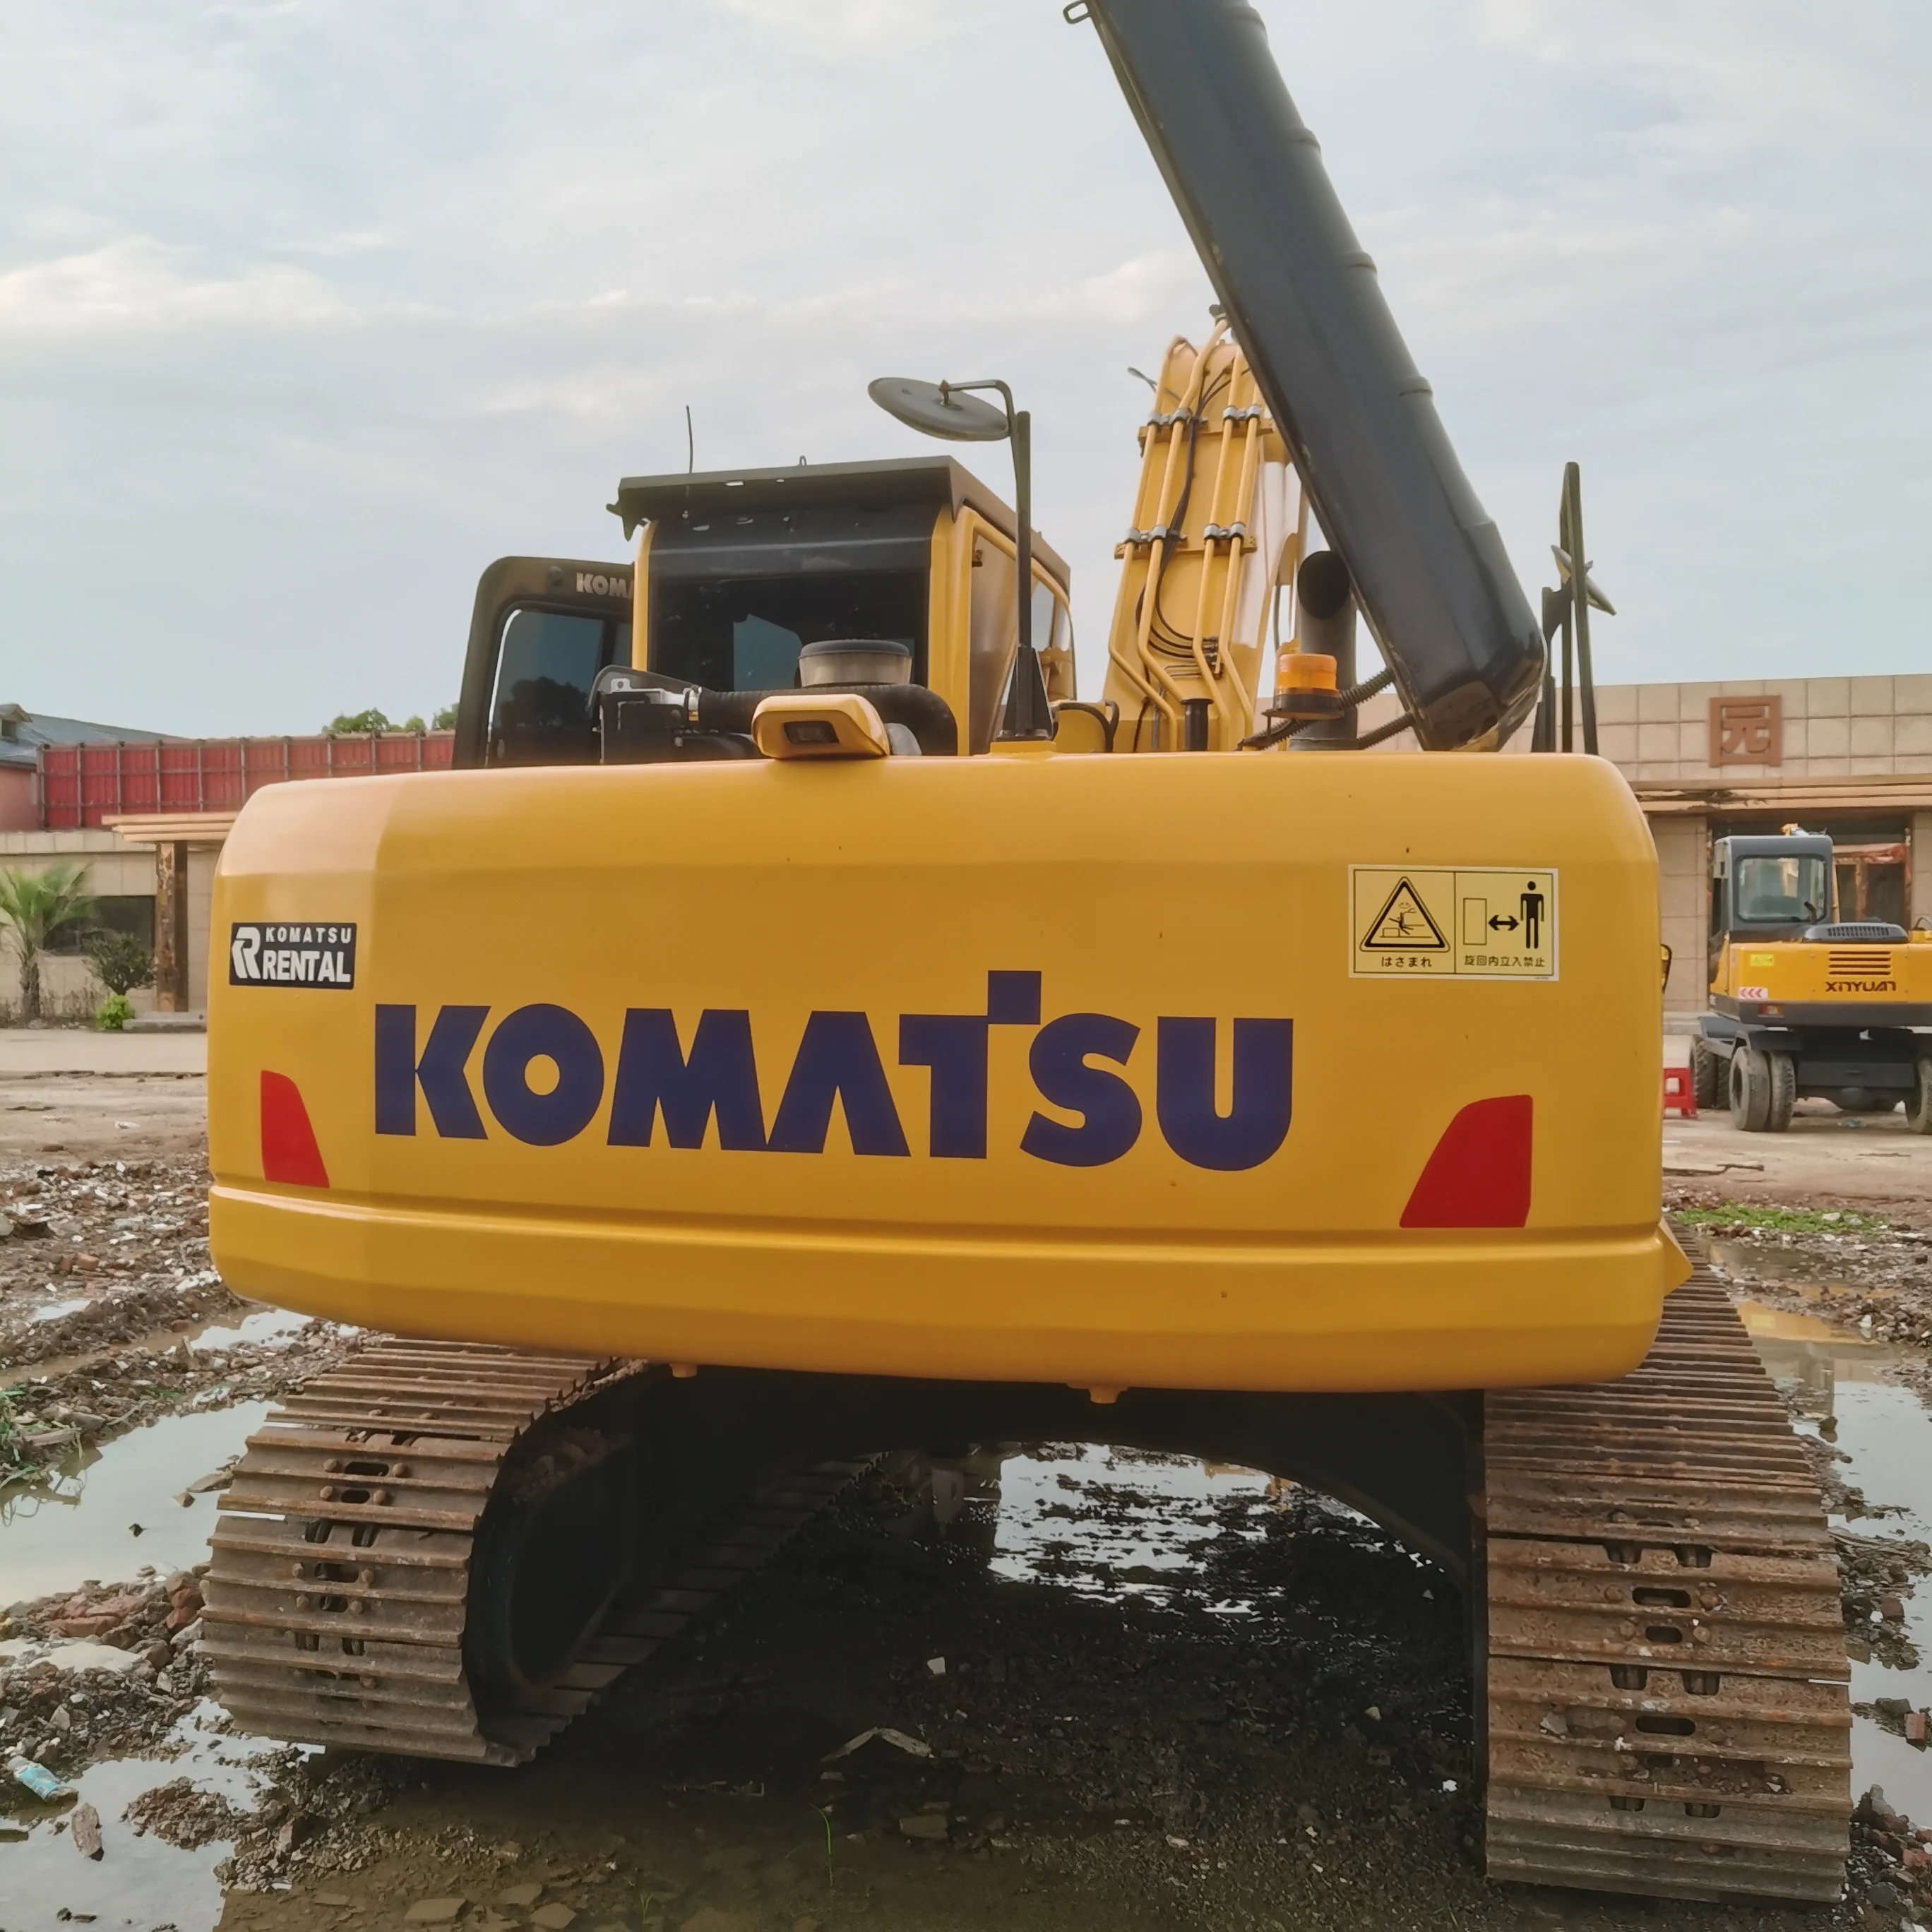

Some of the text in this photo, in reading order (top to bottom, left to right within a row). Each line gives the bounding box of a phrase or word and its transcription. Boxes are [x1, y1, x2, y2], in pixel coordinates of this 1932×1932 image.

[1710, 696, 1782, 768] 园
[266, 926, 352, 943] KOMATSU
[263, 950, 351, 982] RENTAL
[1381, 956, 1432, 968] はさまれ
[1464, 955, 1545, 967] 旋回内立入禁止
[375, 970, 1294, 1171] KOMATSU
